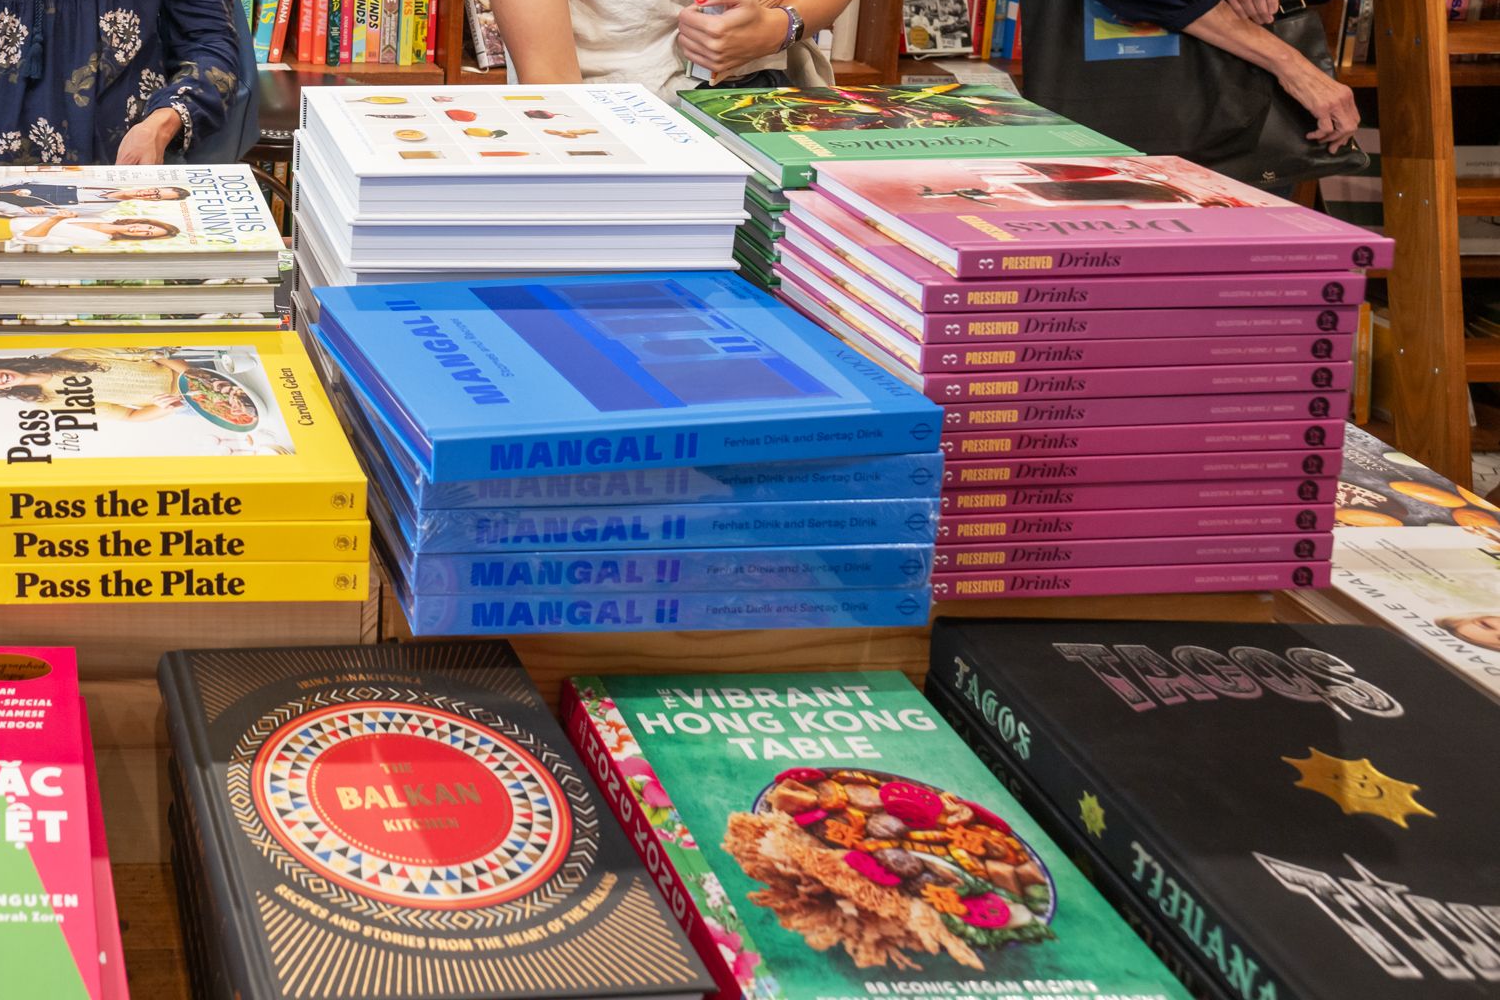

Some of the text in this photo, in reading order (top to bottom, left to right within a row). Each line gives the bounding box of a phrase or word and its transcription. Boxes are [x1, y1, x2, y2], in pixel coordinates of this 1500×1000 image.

[827, 134, 1012, 154] Vegetables
[185, 168, 238, 244] TASTE FUNNY?
[218, 175, 266, 232] DOES THIS
[1003, 216, 1194, 236] Drinks
[1001, 254, 1054, 271] PRESERVED
[1056, 250, 1122, 269] Drinks
[384, 298, 511, 407] MANGAL II
[280, 367, 314, 427] Carolina Gelen
[53, 375, 99, 452] the Plate
[6, 408, 53, 465] Pass
[489, 432, 699, 472] MANGAL II
[723, 434, 762, 448] Ferhat
[763, 433, 791, 446] Dirik
[793, 432, 814, 445] and
[856, 427, 884, 441] Dirik
[9, 489, 242, 520] Pass the Plate
[656, 685, 875, 710] THE VIBRANT
[1051, 641, 1406, 722] TACOS
[635, 708, 938, 735] HONG KONG
[953, 655, 1032, 762] TACOS
[727, 736, 883, 762] TABLE
[379, 762, 414, 775] THE
[336, 781, 482, 813] BALKAN
[383, 817, 460, 833] KITCHEN
[588, 733, 688, 923] HONG KONG
[31, 911, 65, 924] Zorn
[275, 882, 330, 922] RECIPES
[330, 914, 361, 933] AND
[362, 925, 425, 950] STORIES
[428, 937, 473, 953] FROM
[473, 936, 503, 953] THE
[503, 926, 549, 951] HEART
[564, 905, 589, 927] THE
